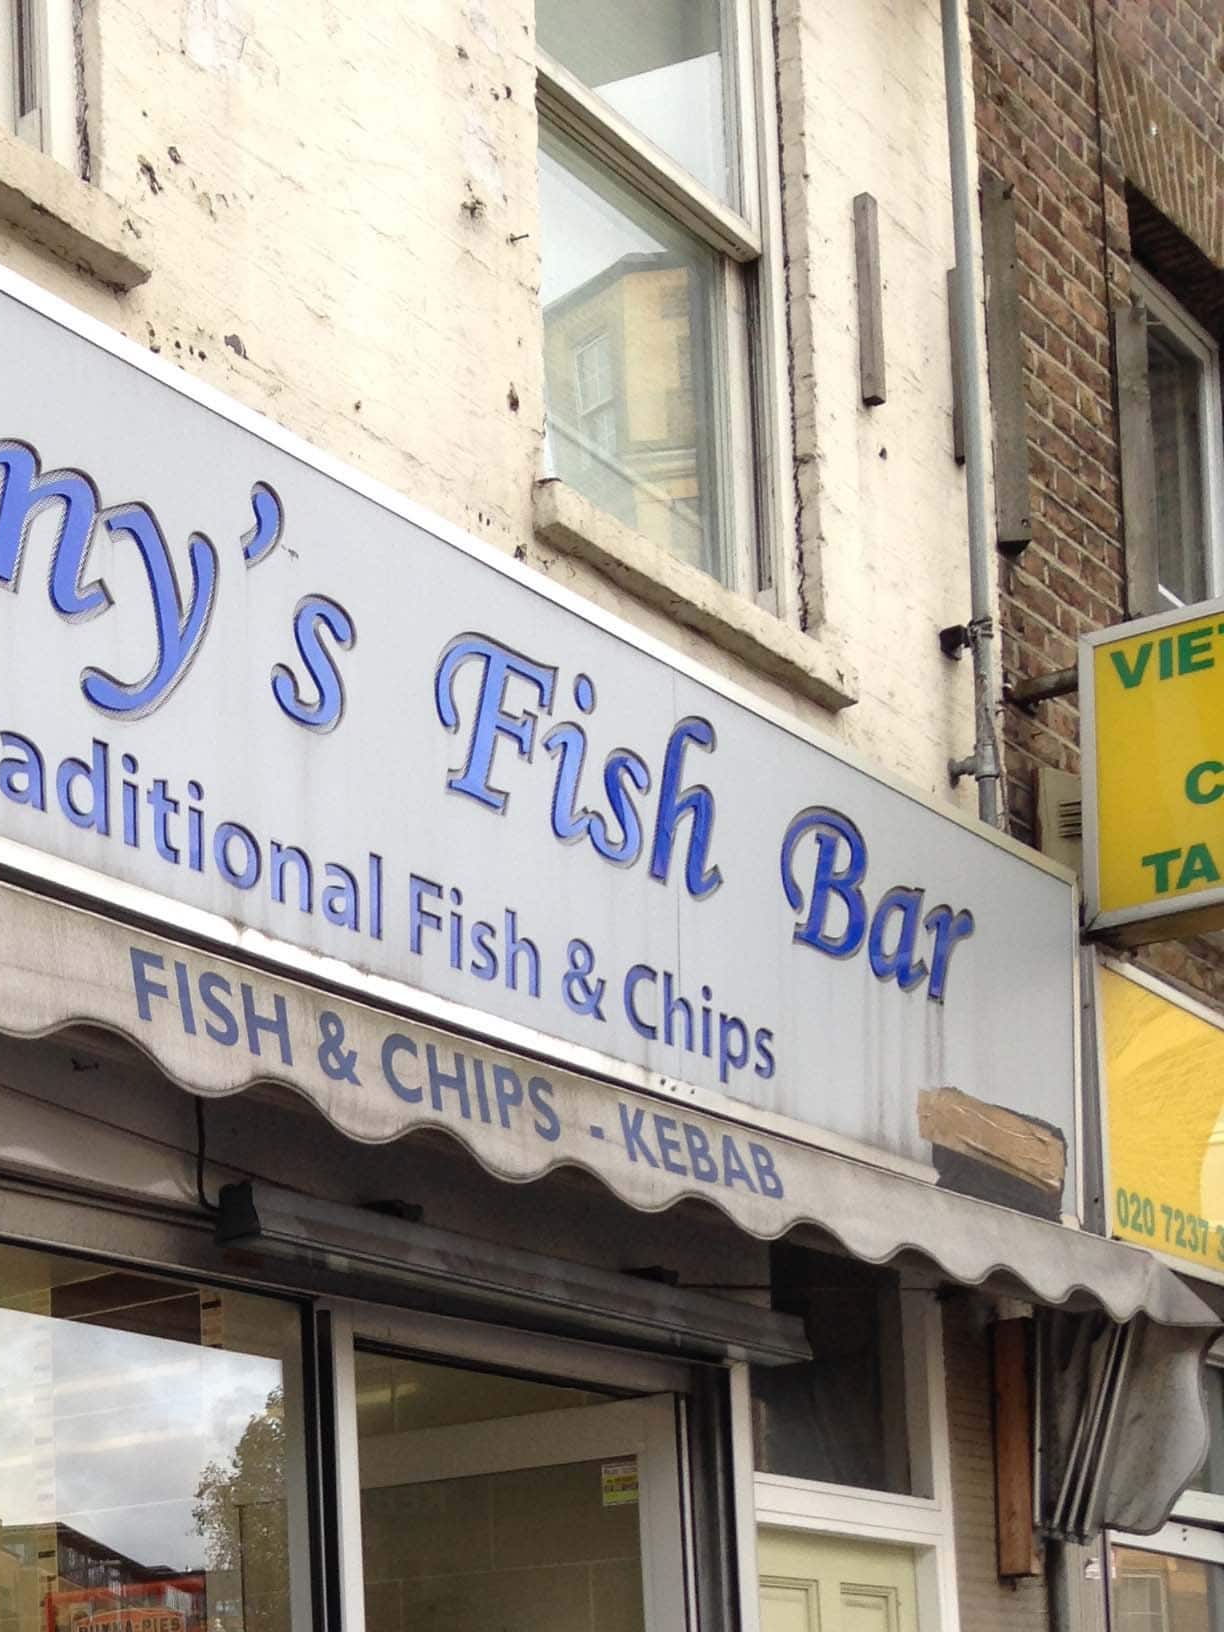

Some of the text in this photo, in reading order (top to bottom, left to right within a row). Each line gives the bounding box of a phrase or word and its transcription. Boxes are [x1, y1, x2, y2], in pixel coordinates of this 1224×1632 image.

[1110, 623, 1224, 689] VIE
[434, 632, 723, 901] Fish
[780, 805, 975, 1005] Bar
[130, 947, 292, 1066] FISH
[318, 1011, 361, 1086] &
[382, 1033, 560, 1142] CHIPS
[617, 1102, 784, 1199] KEBAB
[409, 872, 540, 998] Fish
[561, 939, 607, 1021] &
[624, 963, 776, 1083] Chips
[1117, 1187, 1155, 1237] 020
[1160, 1204, 1209, 1255] 7237
